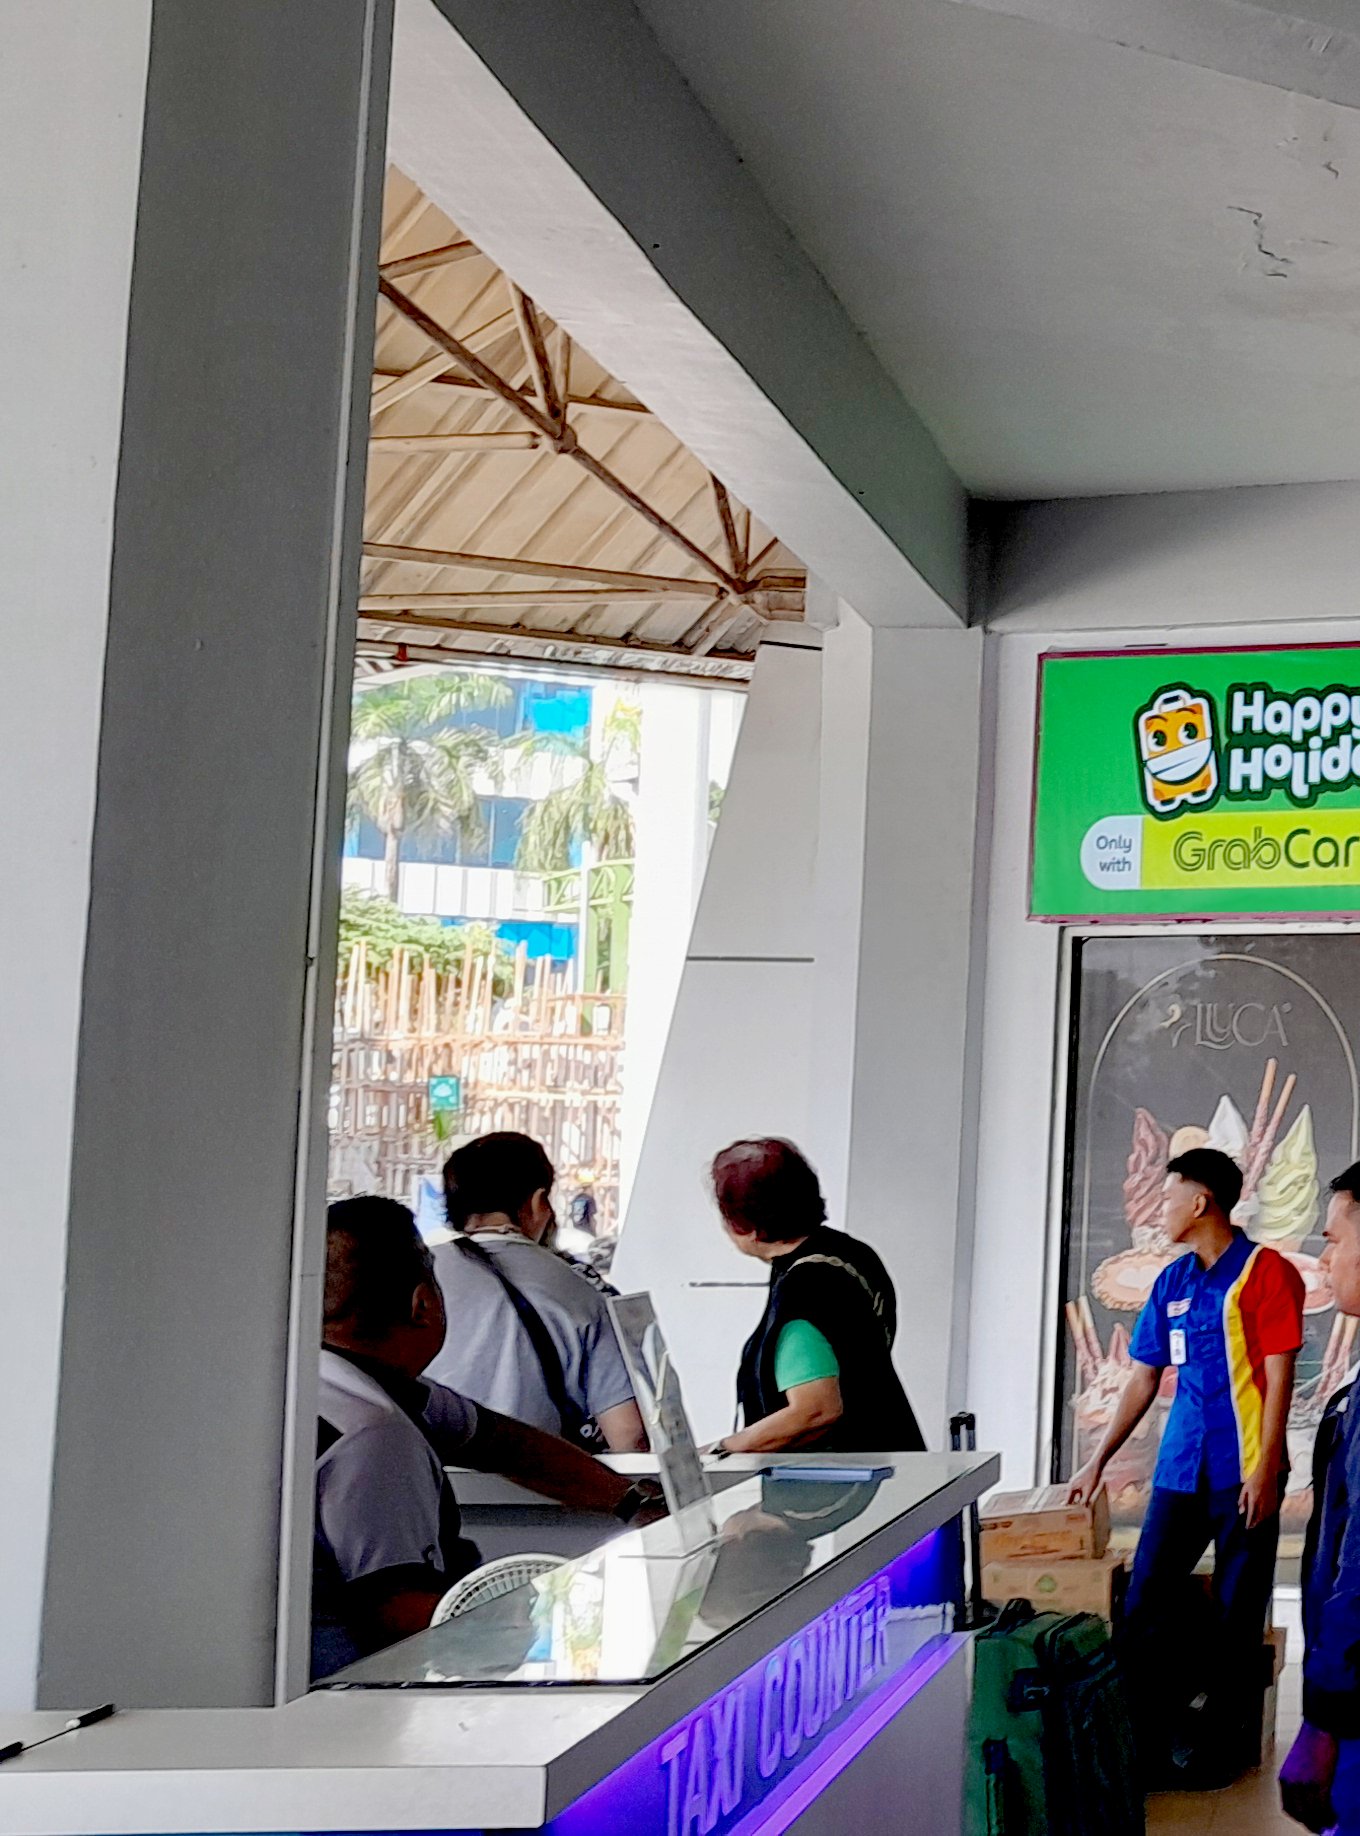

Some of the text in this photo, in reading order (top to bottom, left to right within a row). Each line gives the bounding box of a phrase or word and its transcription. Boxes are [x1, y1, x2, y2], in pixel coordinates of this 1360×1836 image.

[1095, 835, 1133, 855] Only
[1099, 857, 1132, 873] with
[1172, 826, 1360, 872] GrabCar
[1190, 1002, 1290, 1051] LUCA
[660, 1574, 891, 1836] TAXI COUNTER
